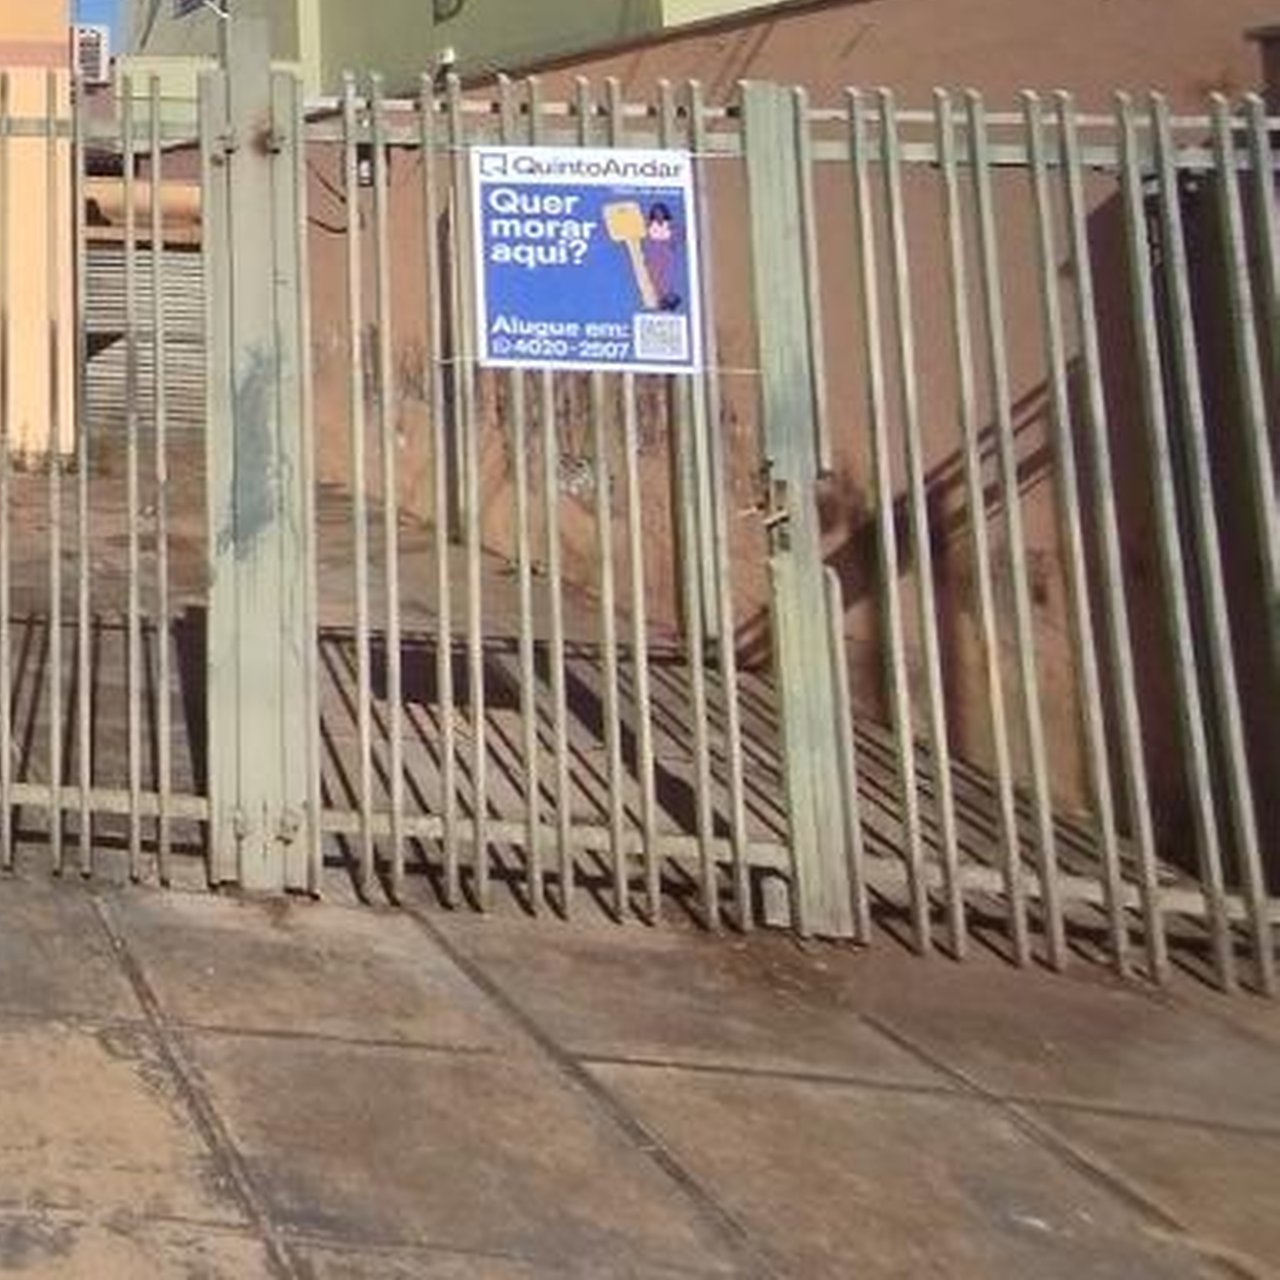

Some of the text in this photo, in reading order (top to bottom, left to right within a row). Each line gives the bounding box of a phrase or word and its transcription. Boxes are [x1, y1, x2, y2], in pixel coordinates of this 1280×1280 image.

[512, 155, 681, 178] QuintoAndar
[489, 188, 579, 215] Quer
[490, 217, 597, 240] morar
[490, 239, 589, 269] aqui?
[492, 315, 578, 338] Alugue
